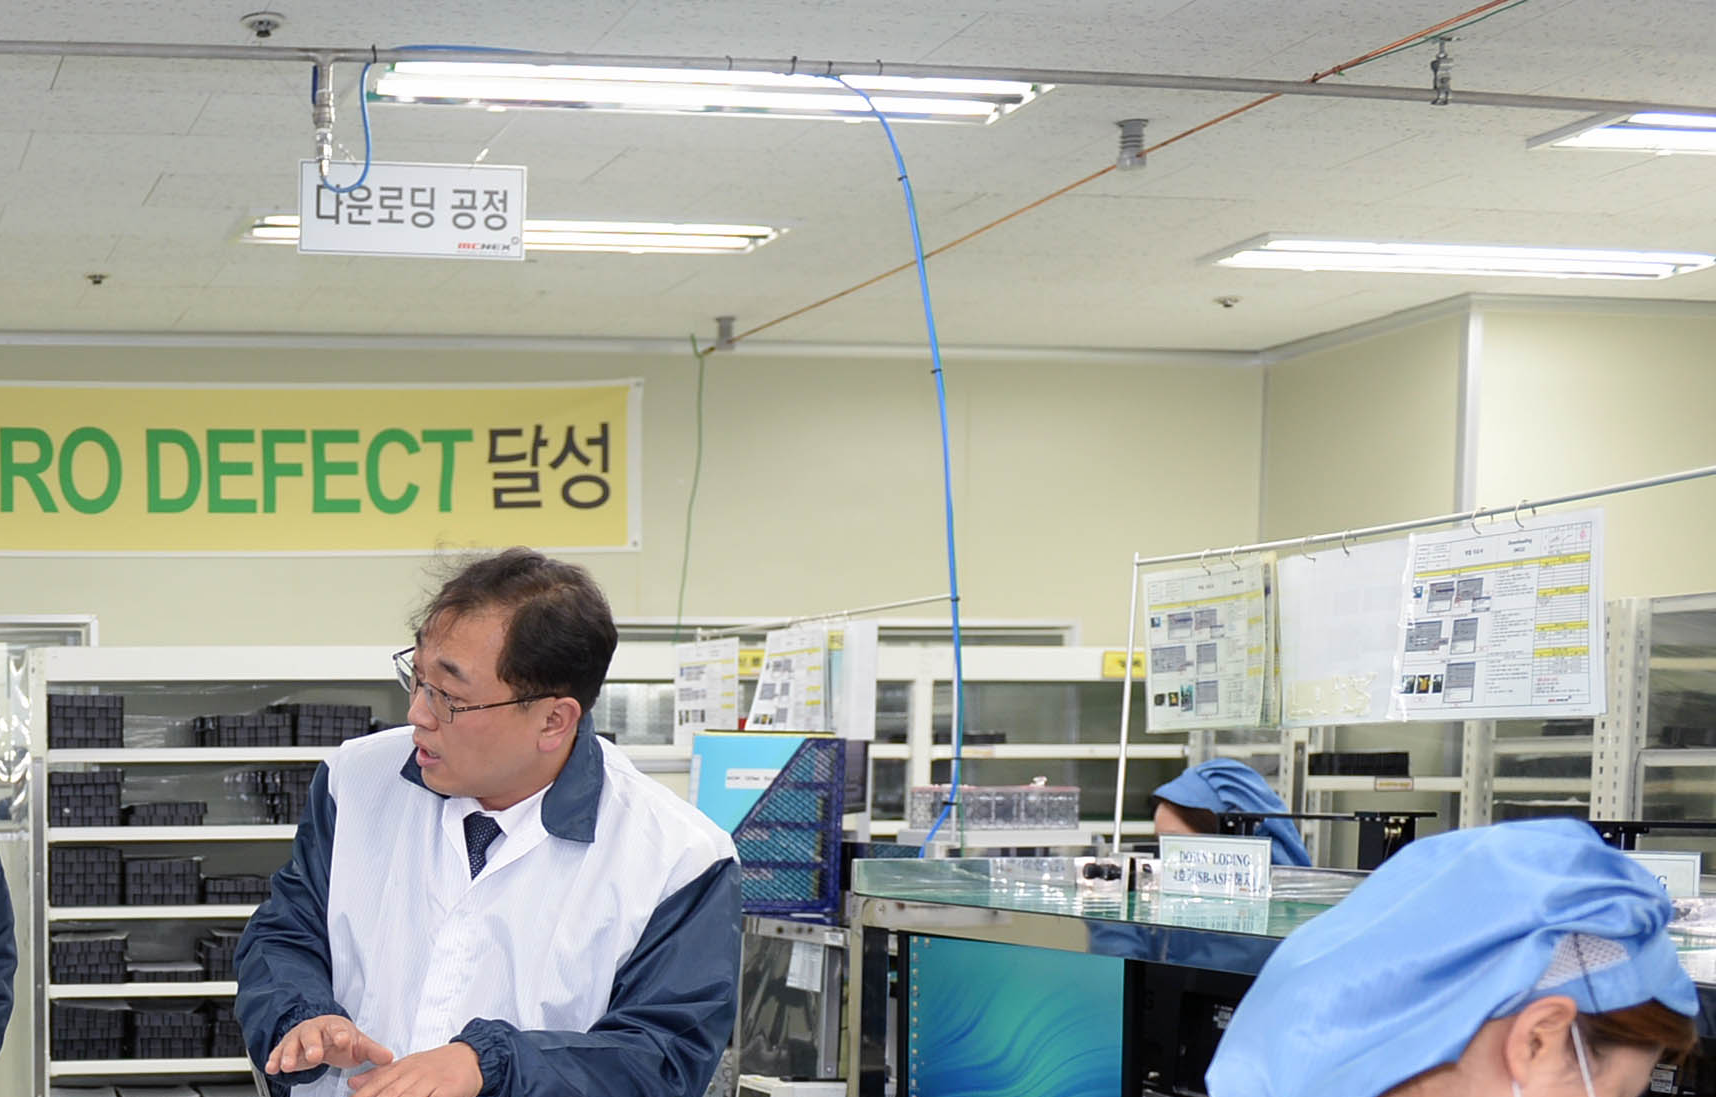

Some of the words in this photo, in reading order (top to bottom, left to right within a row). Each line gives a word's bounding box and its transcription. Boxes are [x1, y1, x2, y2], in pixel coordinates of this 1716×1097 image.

[315, 183, 436, 229] 다운로딩
[450, 188, 509, 231] 공정
[145, 427, 474, 515] DEFECT
[487, 421, 613, 510] 달성
